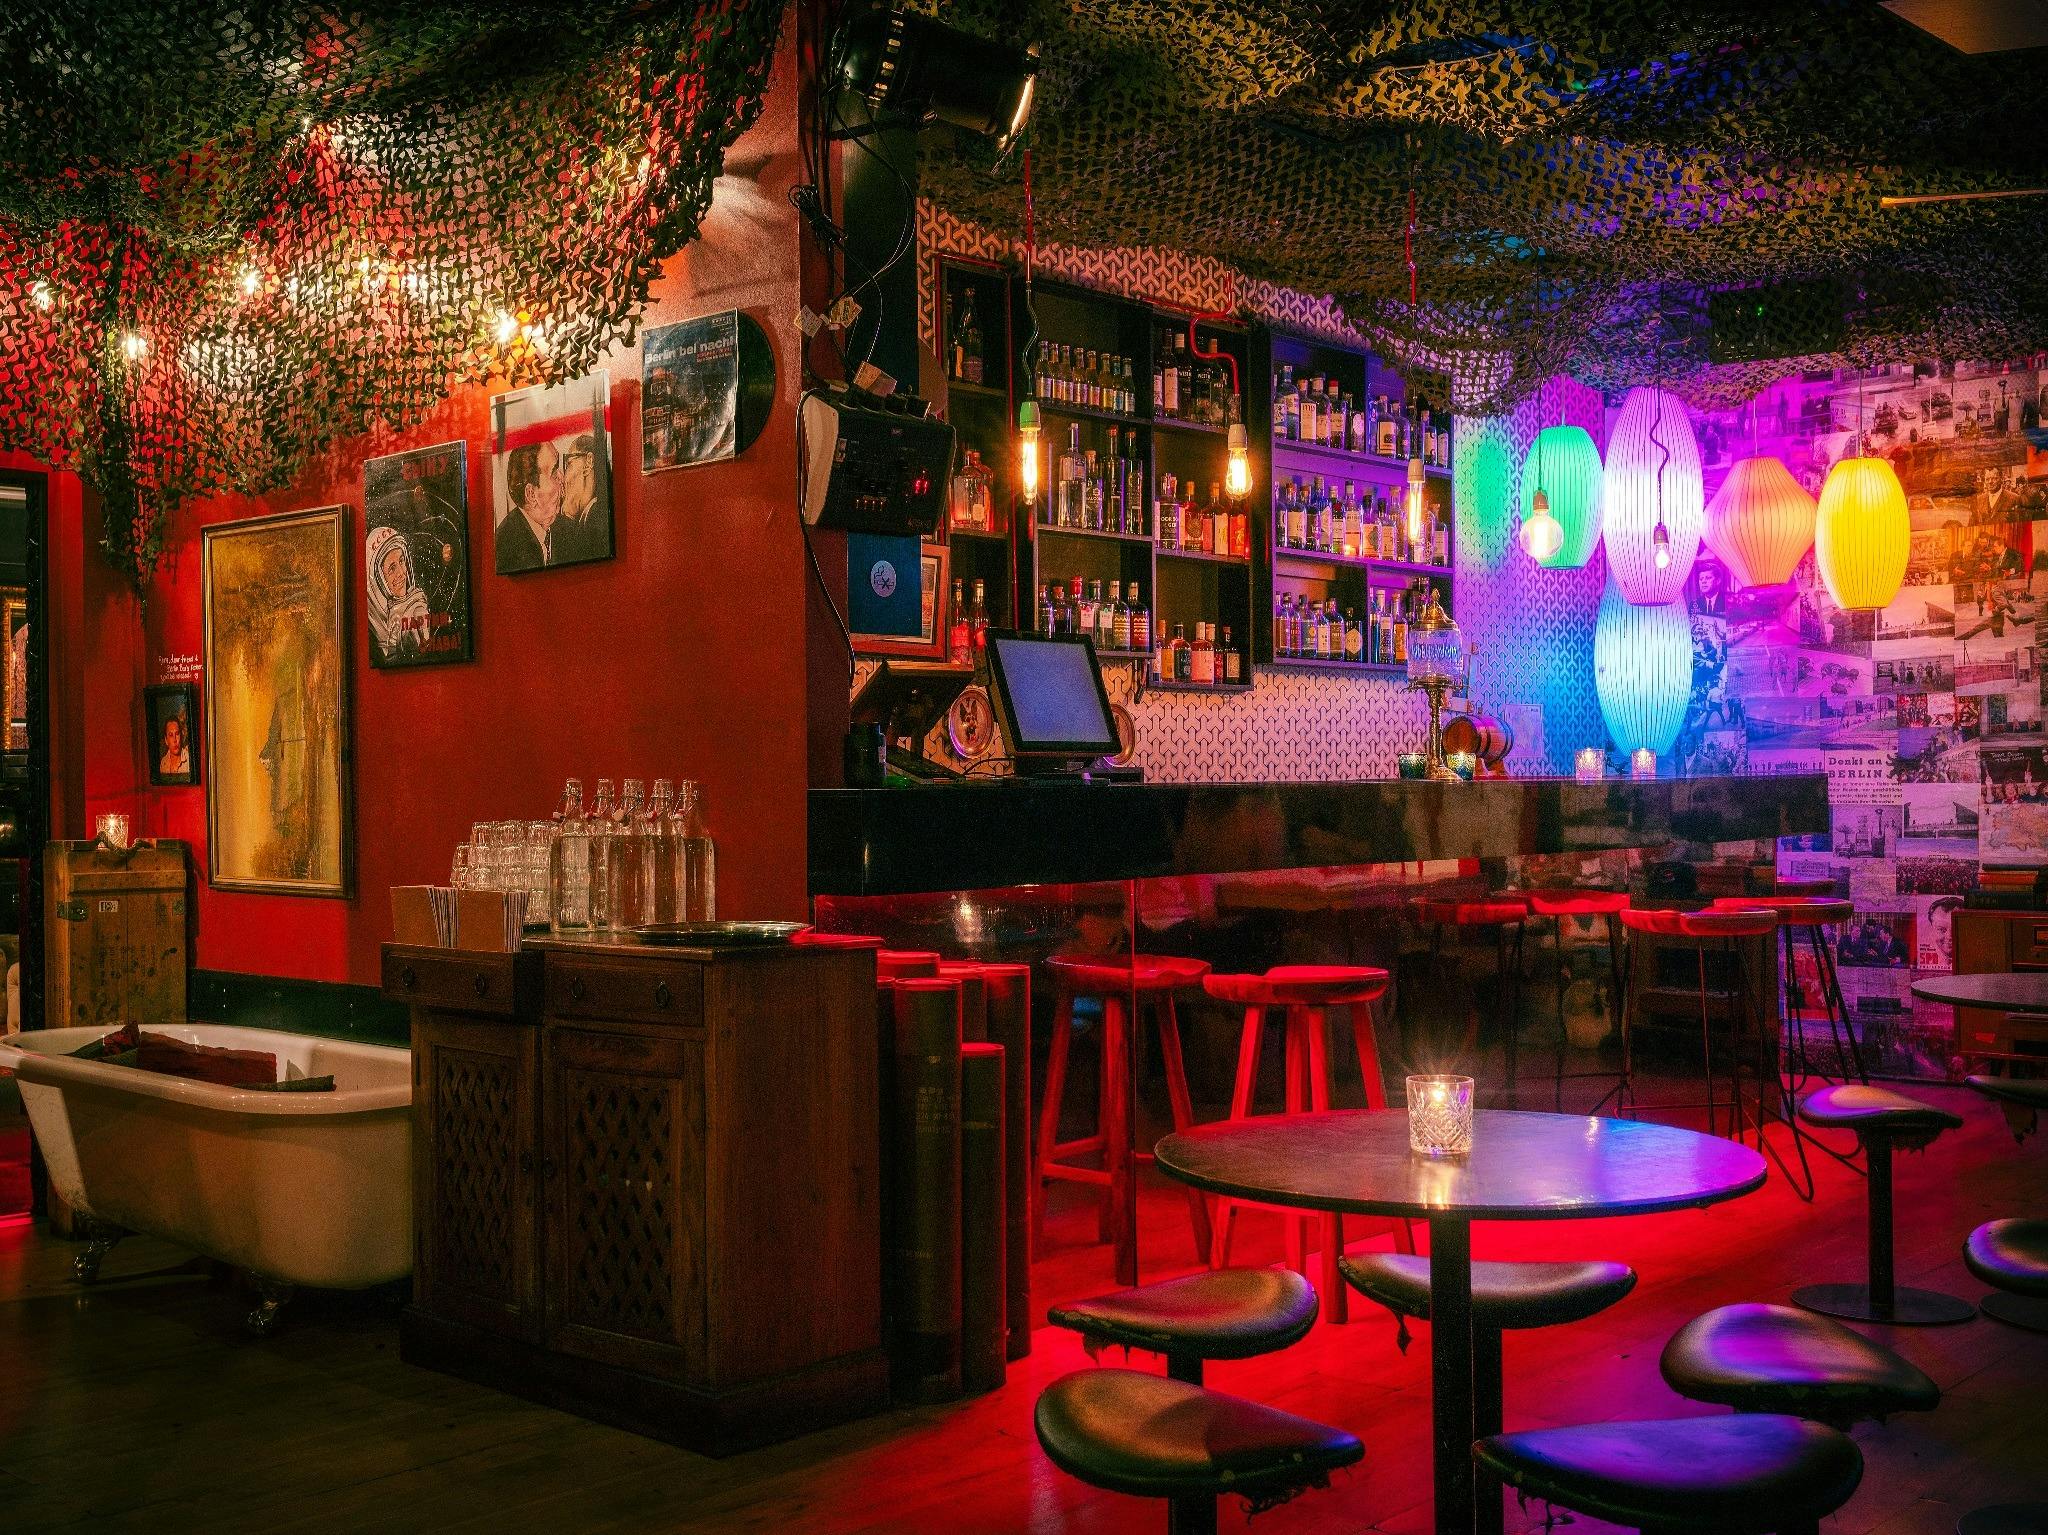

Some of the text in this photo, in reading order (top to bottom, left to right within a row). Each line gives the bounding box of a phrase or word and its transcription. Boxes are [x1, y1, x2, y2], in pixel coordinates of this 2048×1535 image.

[645, 348, 677, 364] Berlin
[700, 336, 736, 354] nacht
[1828, 770, 1882, 778] BERLIN
[1920, 953, 1938, 964] SPD
